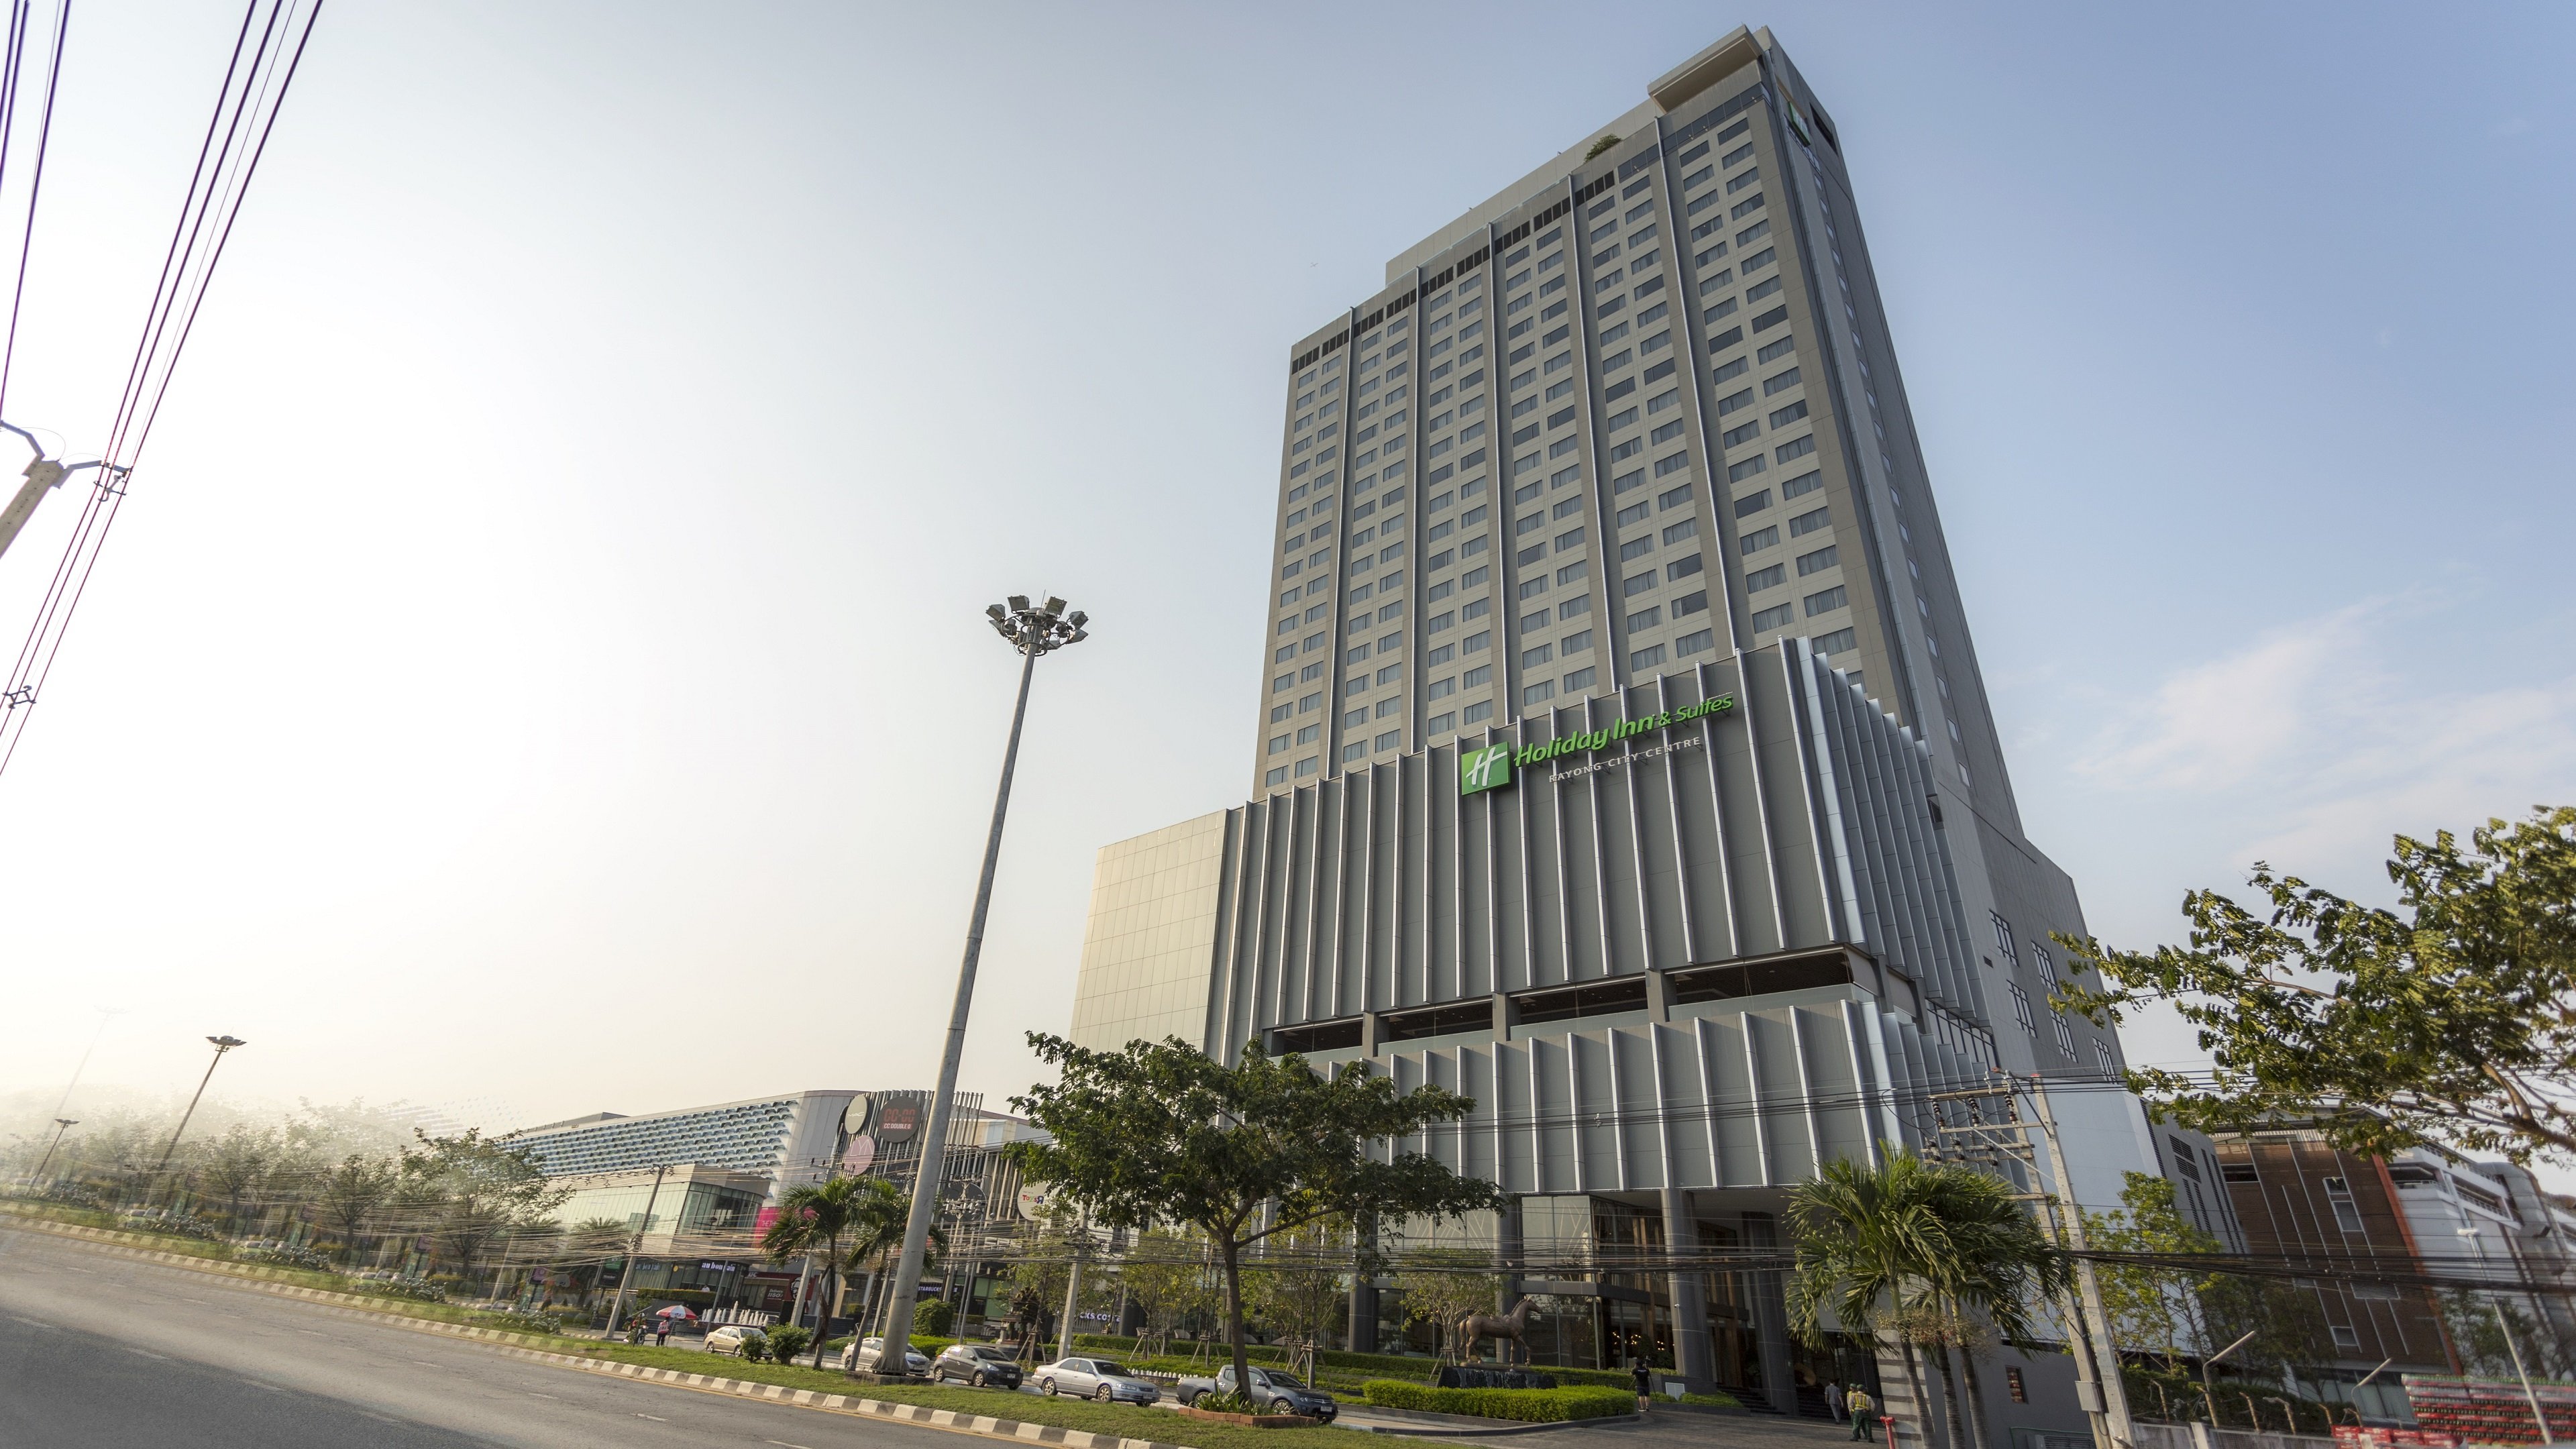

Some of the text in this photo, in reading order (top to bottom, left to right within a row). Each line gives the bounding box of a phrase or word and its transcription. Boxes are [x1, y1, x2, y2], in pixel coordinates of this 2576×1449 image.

[1513, 696, 1733, 767] Holiday Inn & Suites
[1548, 737, 1701, 783] RAYONG CITY CENTRE
[711, 1261, 723, 1270] bon
[725, 1264, 735, 1272] ain
